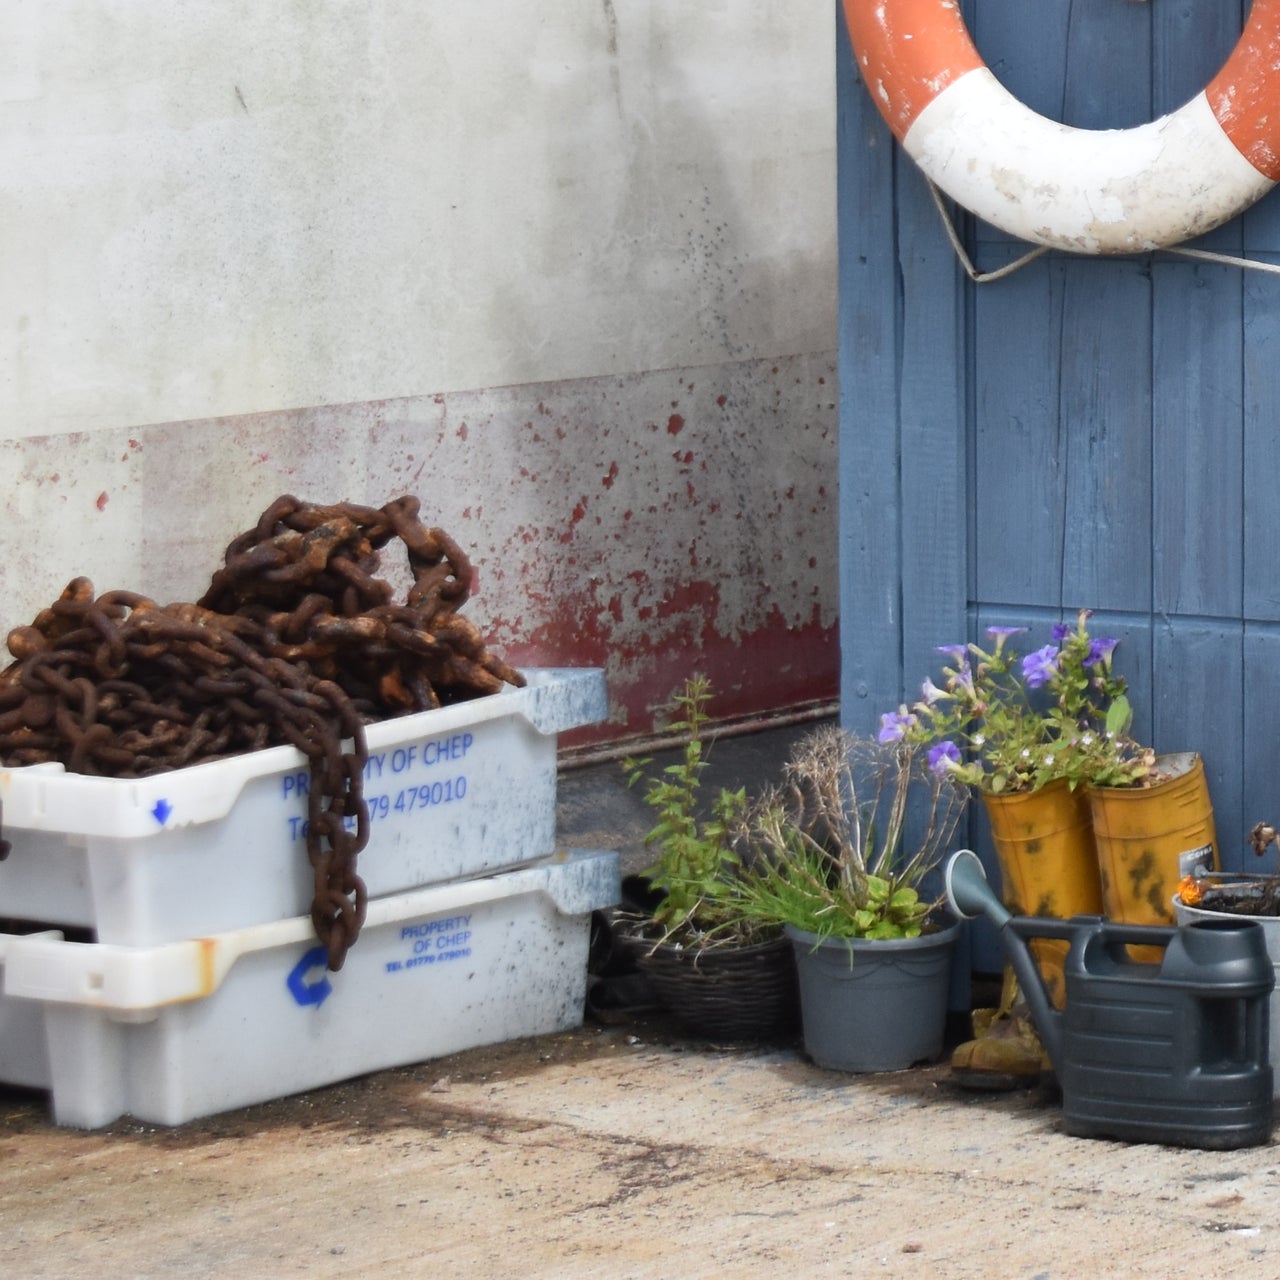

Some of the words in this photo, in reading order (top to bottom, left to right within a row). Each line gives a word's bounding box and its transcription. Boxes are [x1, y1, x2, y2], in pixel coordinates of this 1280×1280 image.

[391, 745, 417, 773] OF
[423, 732, 474, 765] CHEP
[394, 775, 467, 812] 479010
[401, 914, 472, 939] PROPERTY
[413, 938, 432, 953] OF
[436, 931, 472, 949] CHEP
